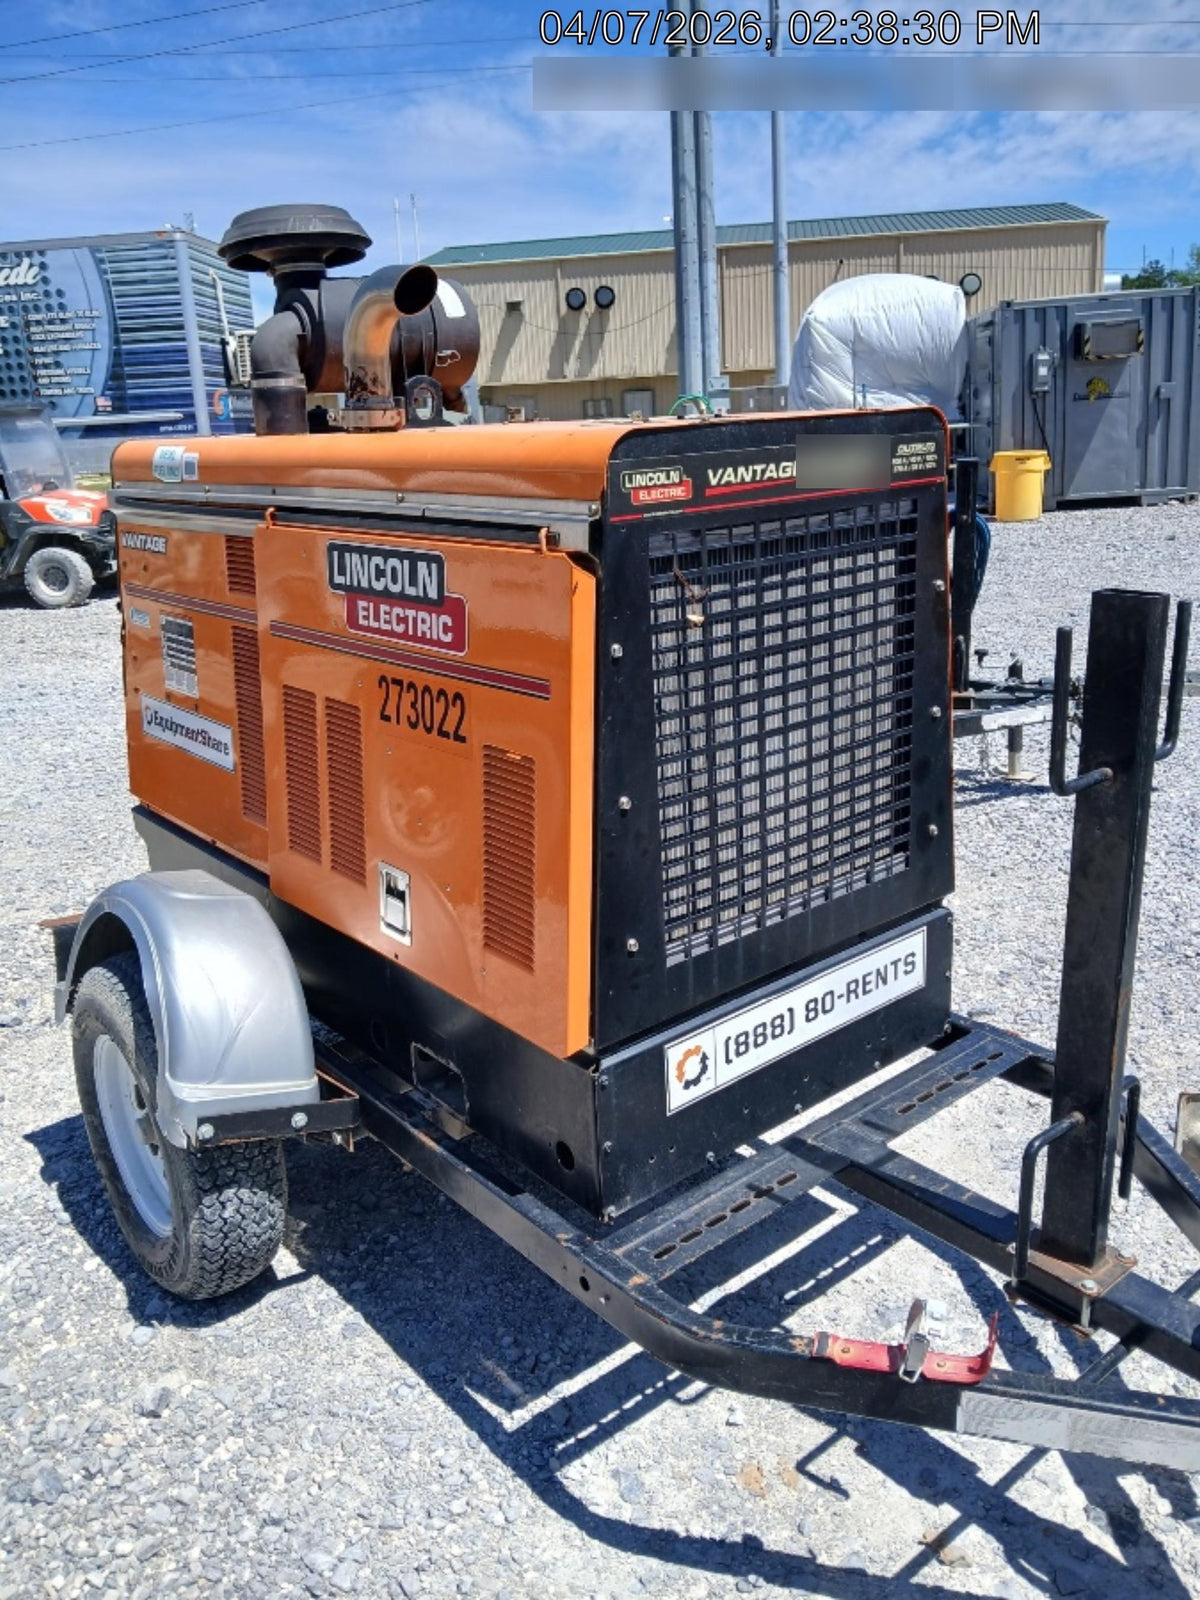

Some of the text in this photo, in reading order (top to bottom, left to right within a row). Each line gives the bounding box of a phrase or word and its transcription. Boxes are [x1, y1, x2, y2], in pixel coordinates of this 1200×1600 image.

[624, 471, 680, 488] LINCOLN
[639, 487, 686, 501] ELECTRIC
[707, 461, 797, 486] VANTAG
[122, 532, 167, 553] VANTAGE
[332, 550, 439, 600] LINCOLN
[356, 600, 453, 643] ELECTRIC
[378, 674, 467, 744] 273022
[153, 709, 230, 756] EquipmentShare
[724, 950, 917, 1064] (888) 80-RENTS
